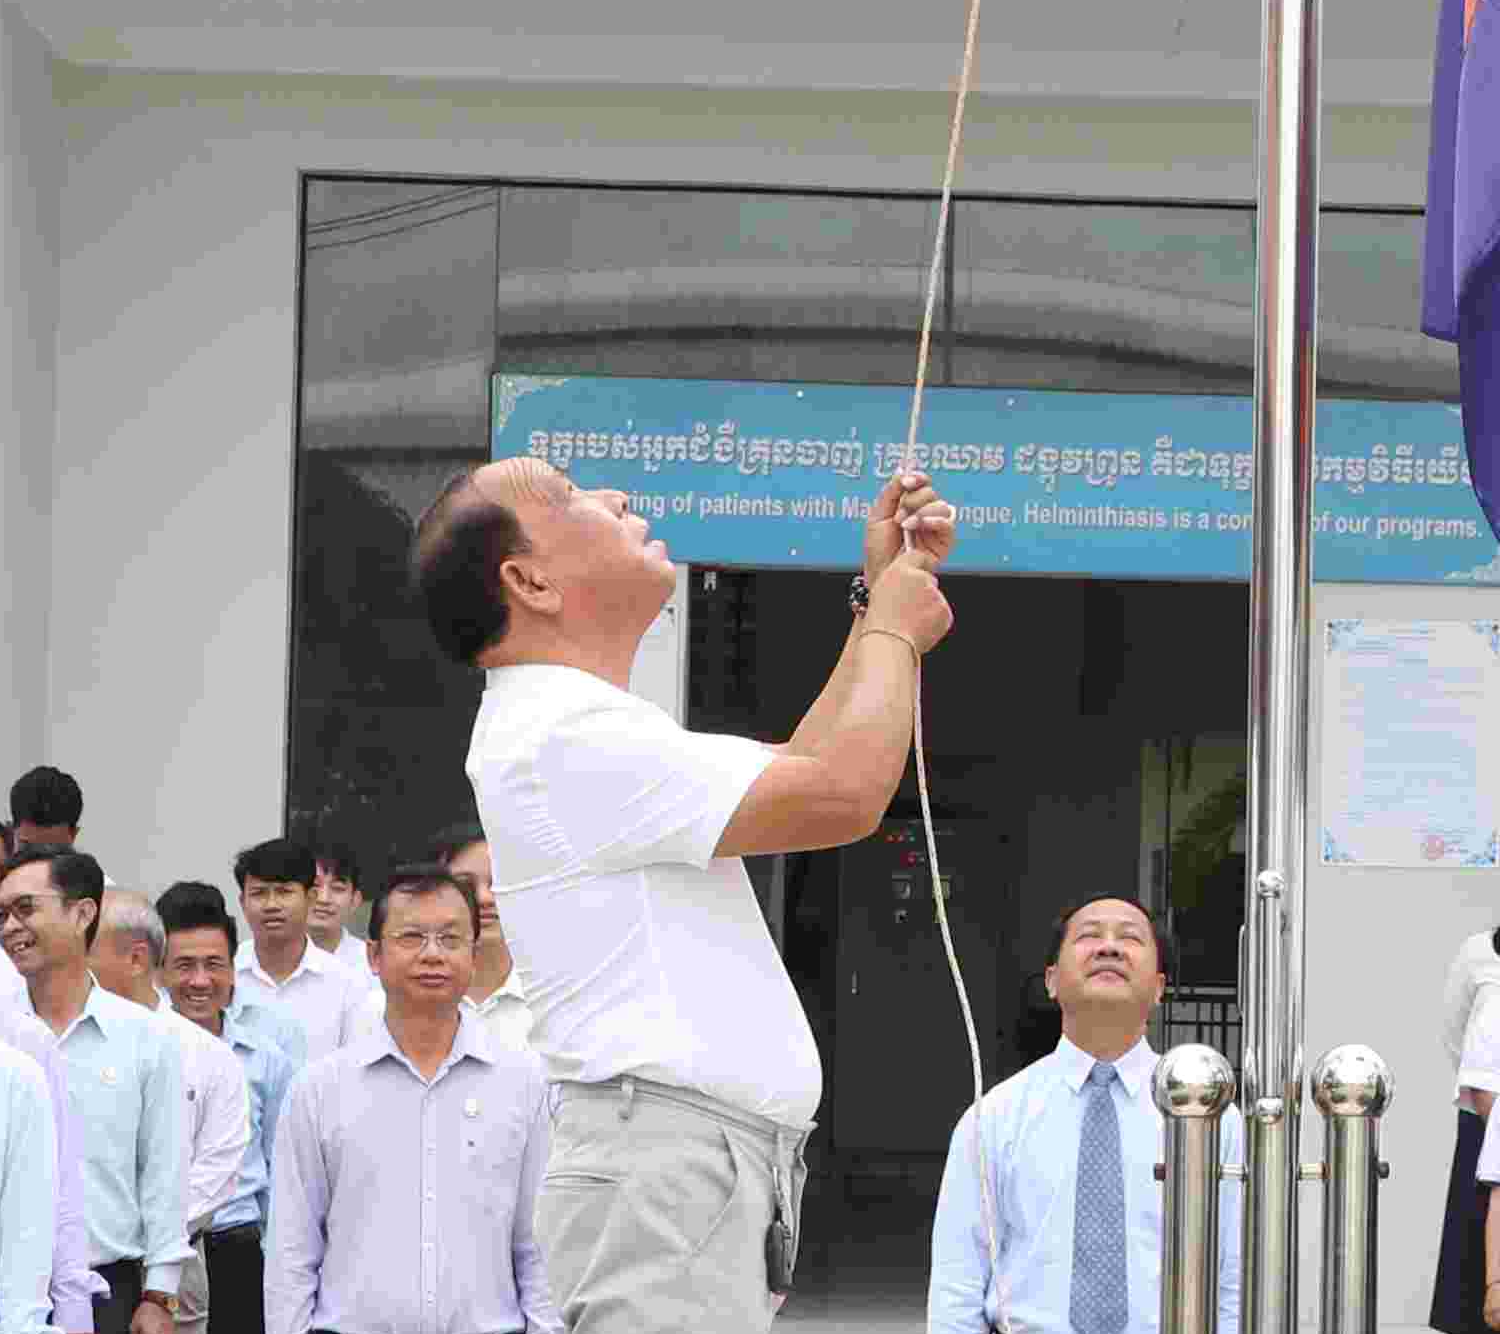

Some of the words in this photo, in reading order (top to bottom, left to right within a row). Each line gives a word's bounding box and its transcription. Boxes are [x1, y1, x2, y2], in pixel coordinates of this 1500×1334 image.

[529, 419, 865, 476] ទក្ខរបស់អ្នកជំងឺគ្រុនចាញ់
[672, 490, 694, 515] of
[699, 492, 784, 519] patients
[790, 493, 835, 518] with
[956, 505, 1015, 528] ngue,
[1023, 502, 1167, 530] Helminthiasis
[1172, 508, 1191, 530] is
[1197, 513, 1210, 530] a
[1336, 516, 1371, 534] our
[1377, 516, 1484, 542] programs.
